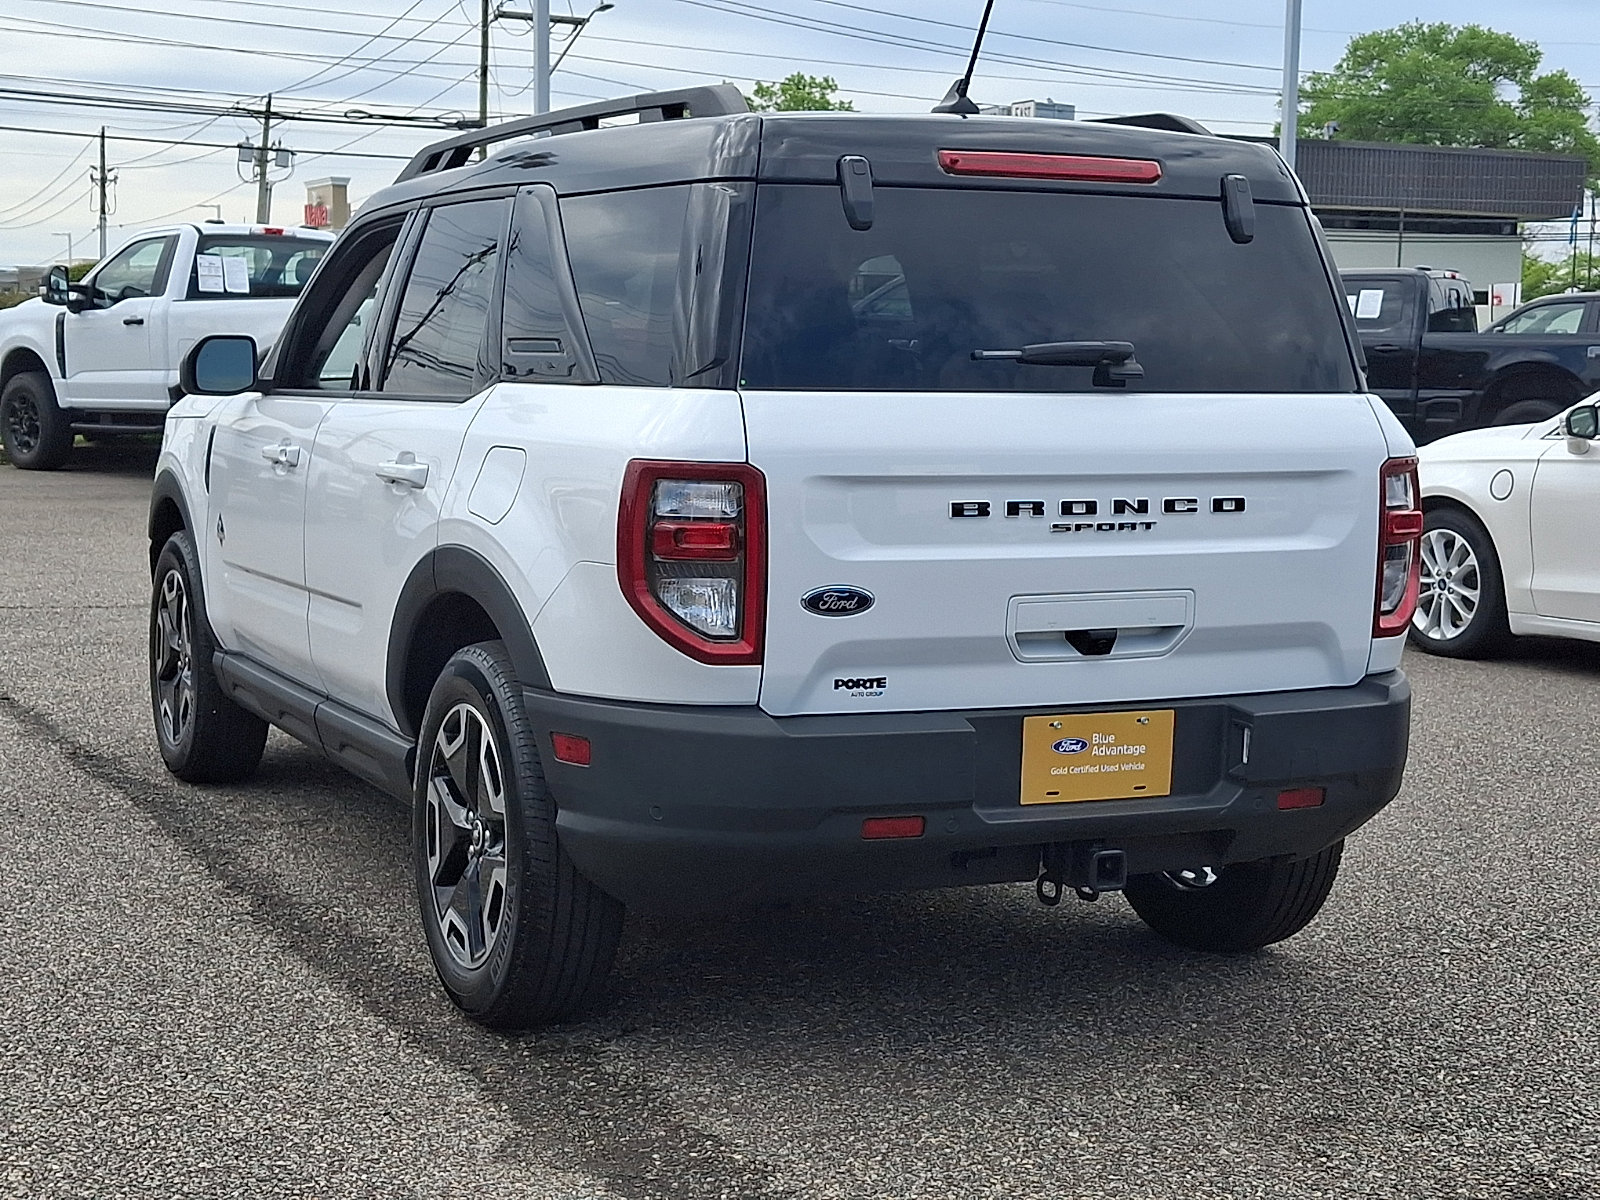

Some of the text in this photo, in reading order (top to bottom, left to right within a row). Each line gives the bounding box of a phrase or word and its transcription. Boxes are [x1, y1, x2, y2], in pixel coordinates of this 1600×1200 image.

[948, 496, 1247, 518] BRONCO
[1050, 521, 1157, 533] SPORT
[818, 592, 859, 609] Ford
[833, 677, 887, 690] PORTE
[1092, 733, 1116, 744] Blue
[1058, 740, 1083, 752] Ford
[1091, 744, 1146, 757] Advantage
[1050, 762, 1145, 775] Gold Certified Used Vehicle
